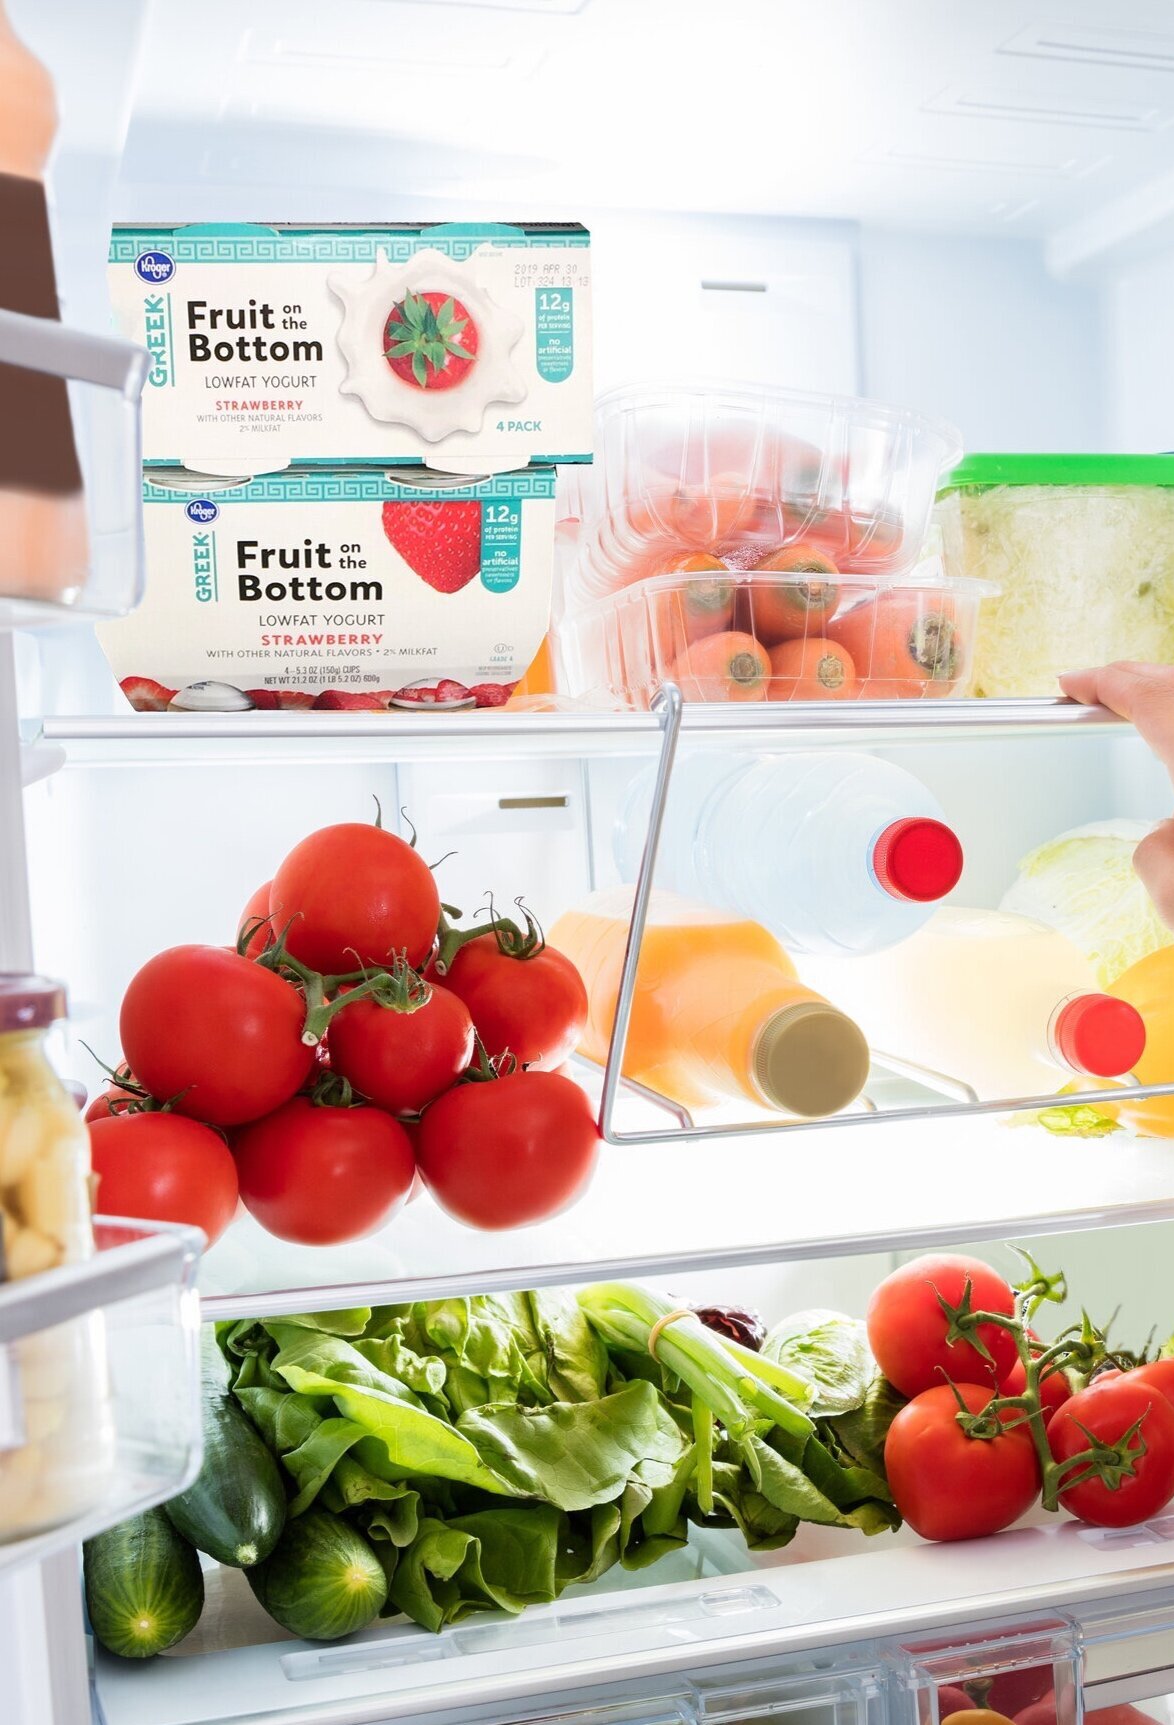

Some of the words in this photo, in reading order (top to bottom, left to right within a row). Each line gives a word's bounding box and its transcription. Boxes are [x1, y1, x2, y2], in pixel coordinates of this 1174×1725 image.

[141, 256, 171, 279] Kroger
[514, 264, 538, 275] 2019
[543, 264, 561, 274] APR
[566, 264, 578, 275] 30
[539, 293, 570, 312] 12g
[187, 299, 275, 330] Fruit
[282, 304, 302, 314] on
[538, 314, 546, 322] of
[547, 314, 570, 322] protein
[282, 316, 308, 330] the
[143, 294, 168, 388] GREEK
[189, 333, 323, 362] Bottom
[538, 346, 571, 354] artificial
[205, 376, 257, 389] LOWFAT
[261, 375, 317, 388] YOGURT
[216, 400, 303, 411] STRAWBERRY
[197, 415, 218, 423] WITH
[220, 414, 246, 423] OTHER
[248, 414, 286, 422] NATURAL
[288, 413, 323, 422] FLAVORS
[251, 424, 282, 433] MILKFAT
[496, 421, 504, 432] 4
[507, 420, 542, 432] PACK
[190, 502, 215, 520] Kroger
[486, 505, 518, 525] 12g
[237, 539, 332, 569] Fruit
[340, 543, 361, 553] on
[192, 532, 212, 602] GREEK
[339, 556, 367, 569] the
[482, 558, 518, 566] artificial
[238, 575, 383, 602] Bottom
[259, 615, 318, 627] LOWFAT
[323, 614, 386, 627] YOGURT
[262, 634, 383, 646] STRAWBERRY
[206, 650, 234, 658] WITH
[237, 650, 271, 658] OTHER
[274, 649, 323, 658] NATURAL
[326, 648, 373, 657] FLAVORS
[399, 647, 438, 656] MILKFAT
[296, 667, 307, 675] 5.3
[308, 667, 318, 675] OZ
[319, 666, 341, 675] (150g)
[342, 666, 361, 674] CUPS
[264, 677, 276, 685] NET
[308, 676, 318, 684] OZ
[327, 675, 337, 683] LB
[338, 675, 349, 683] 5.2
